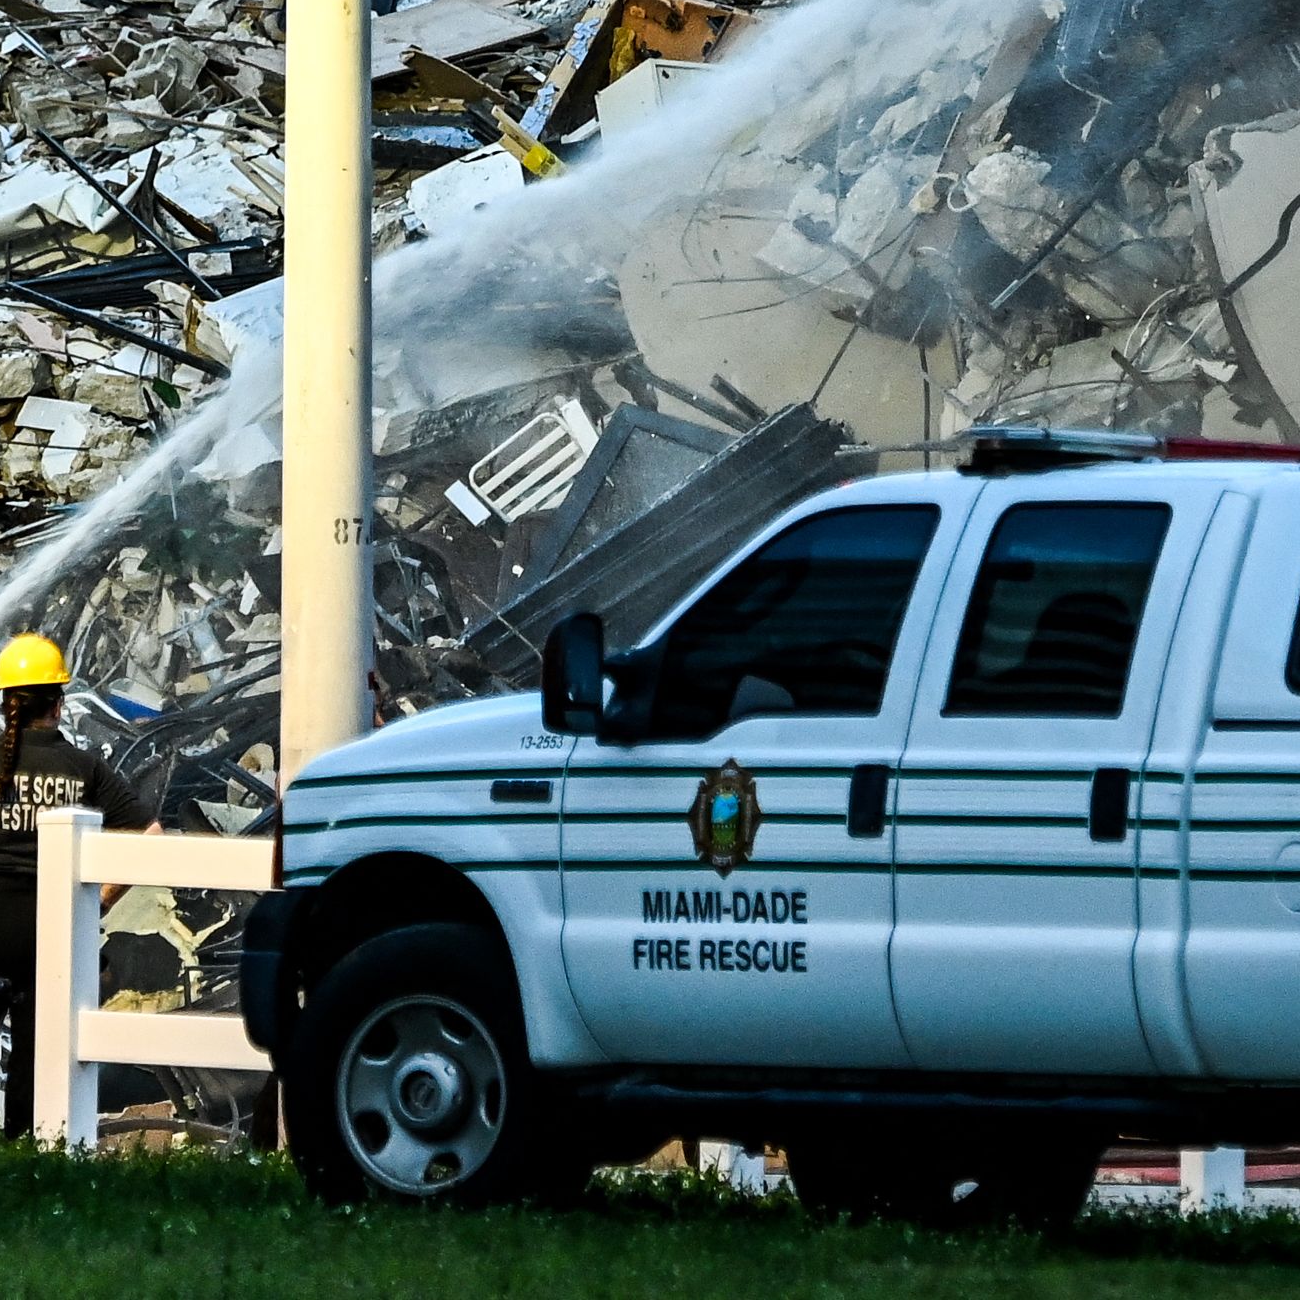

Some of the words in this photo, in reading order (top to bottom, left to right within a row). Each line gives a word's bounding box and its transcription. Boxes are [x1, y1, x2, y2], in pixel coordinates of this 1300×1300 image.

[520, 735, 564, 750] 13-2553
[32, 774, 85, 807] SCENE
[641, 890, 808, 926] MIAMI-DADE
[632, 939, 691, 971] FIRE
[699, 938, 808, 972] RESCUE
